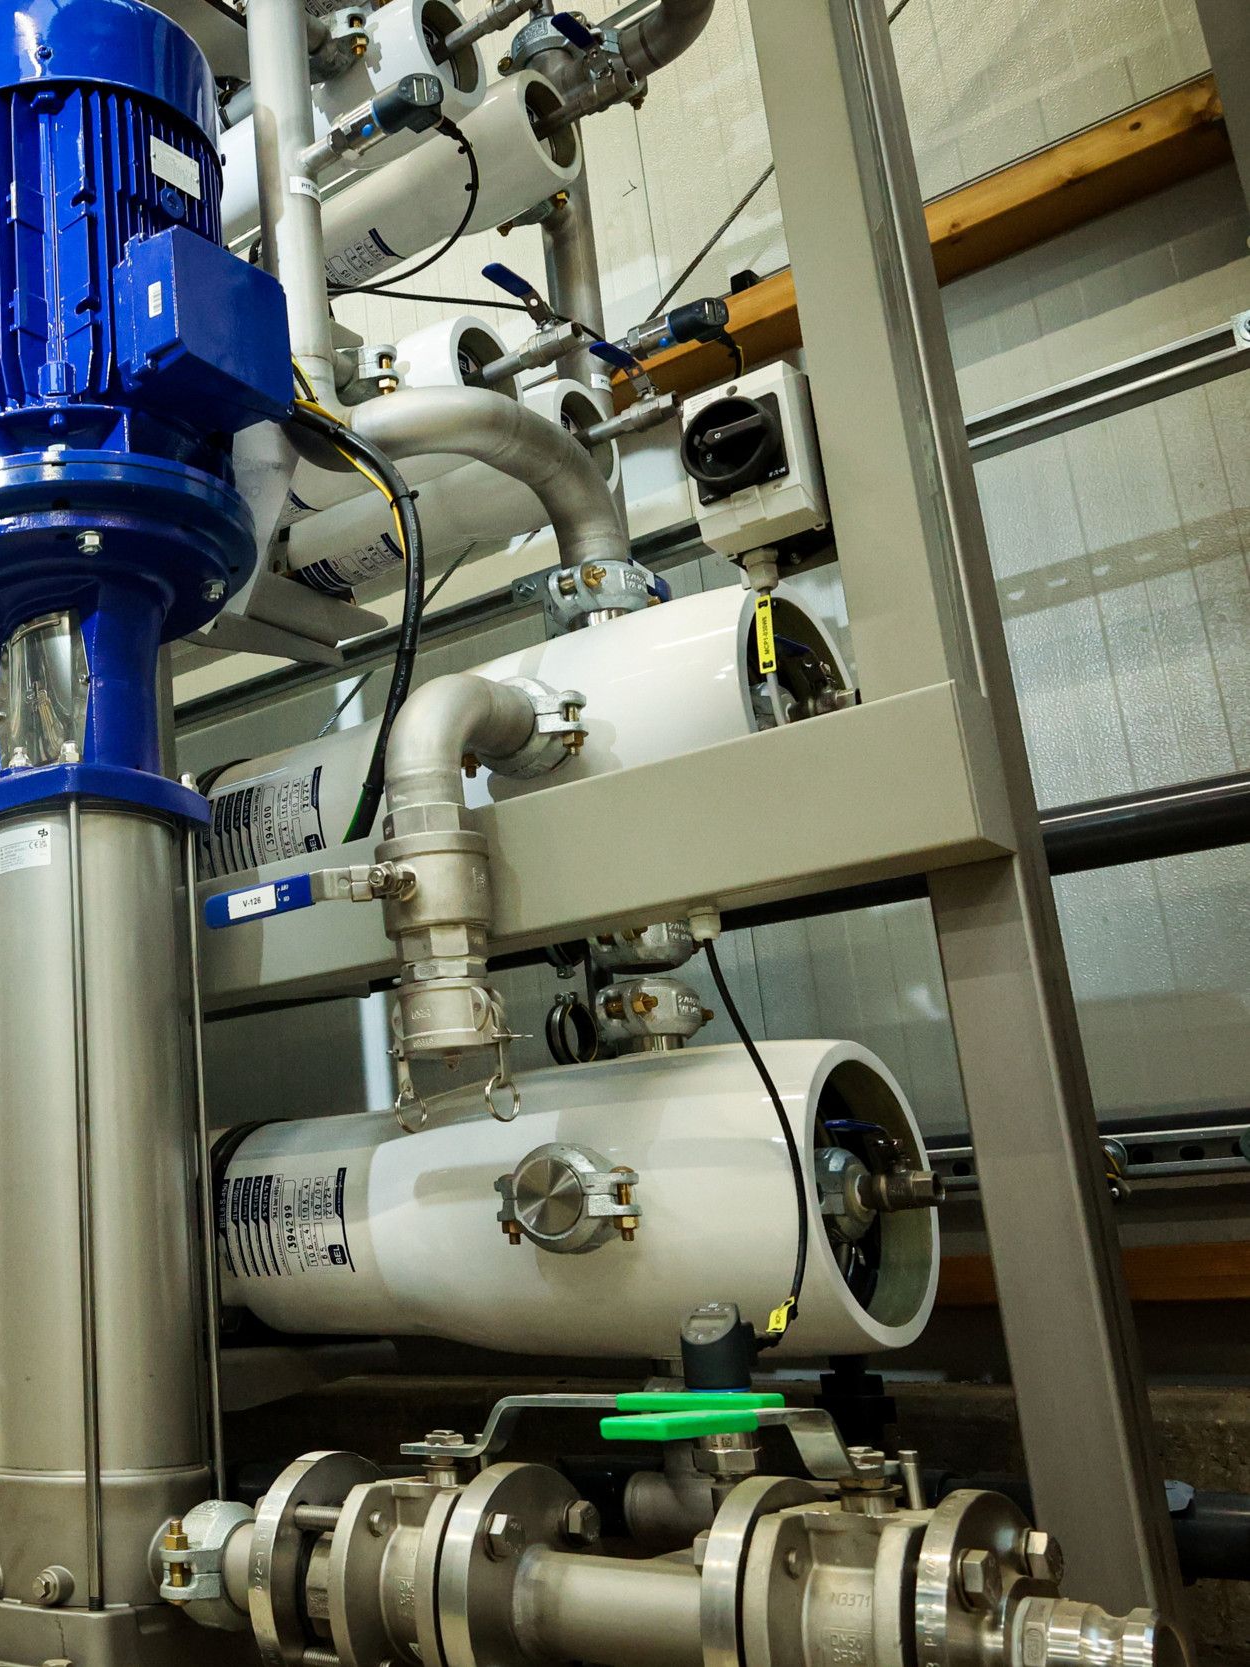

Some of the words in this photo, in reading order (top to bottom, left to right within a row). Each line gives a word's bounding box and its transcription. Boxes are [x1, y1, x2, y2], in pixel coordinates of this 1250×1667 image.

[264, 805, 275, 845] 394300
[242, 896, 262, 908] V-126
[325, 1187, 333, 1215] 2024
[284, 1205, 297, 1249] 394299
[333, 1245, 343, 1264] BEL
